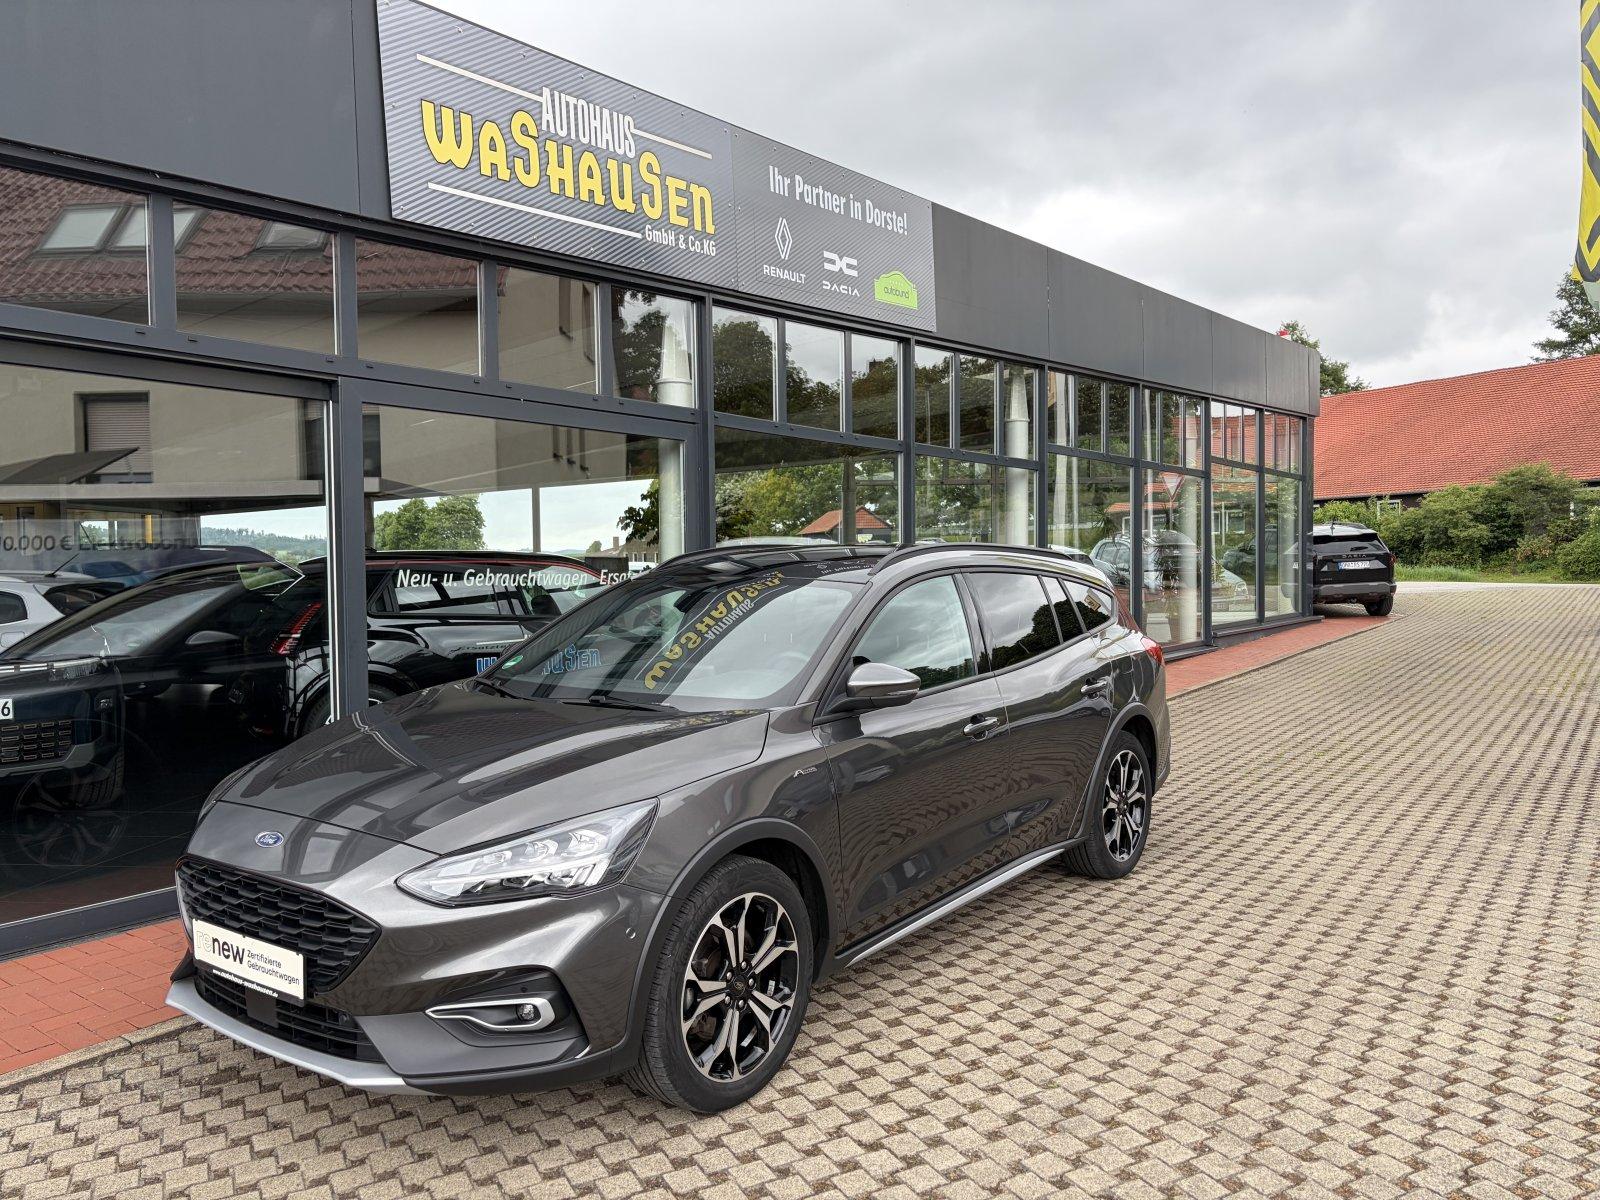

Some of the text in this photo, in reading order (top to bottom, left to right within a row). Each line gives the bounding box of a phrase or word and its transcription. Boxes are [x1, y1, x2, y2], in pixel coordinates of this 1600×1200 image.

[542, 87, 636, 158] AUTOHAUS
[769, 165, 908, 235] Ihr Partner in Dorste!
[645, 224, 716, 256] GmbH & Co.KG
[763, 264, 806, 284] RENAULT
[822, 280, 860, 297] DACIA
[0, 535, 55, 551] 0.000
[60, 535, 73, 551] €
[397, 568, 438, 588] Neu-
[443, 573, 458, 588] u.
[463, 568, 588, 591] Gebrauchtwagen
[247, 950, 282, 969] Zertifizierte
[247, 960, 300, 986] Gebrauchtwagen
